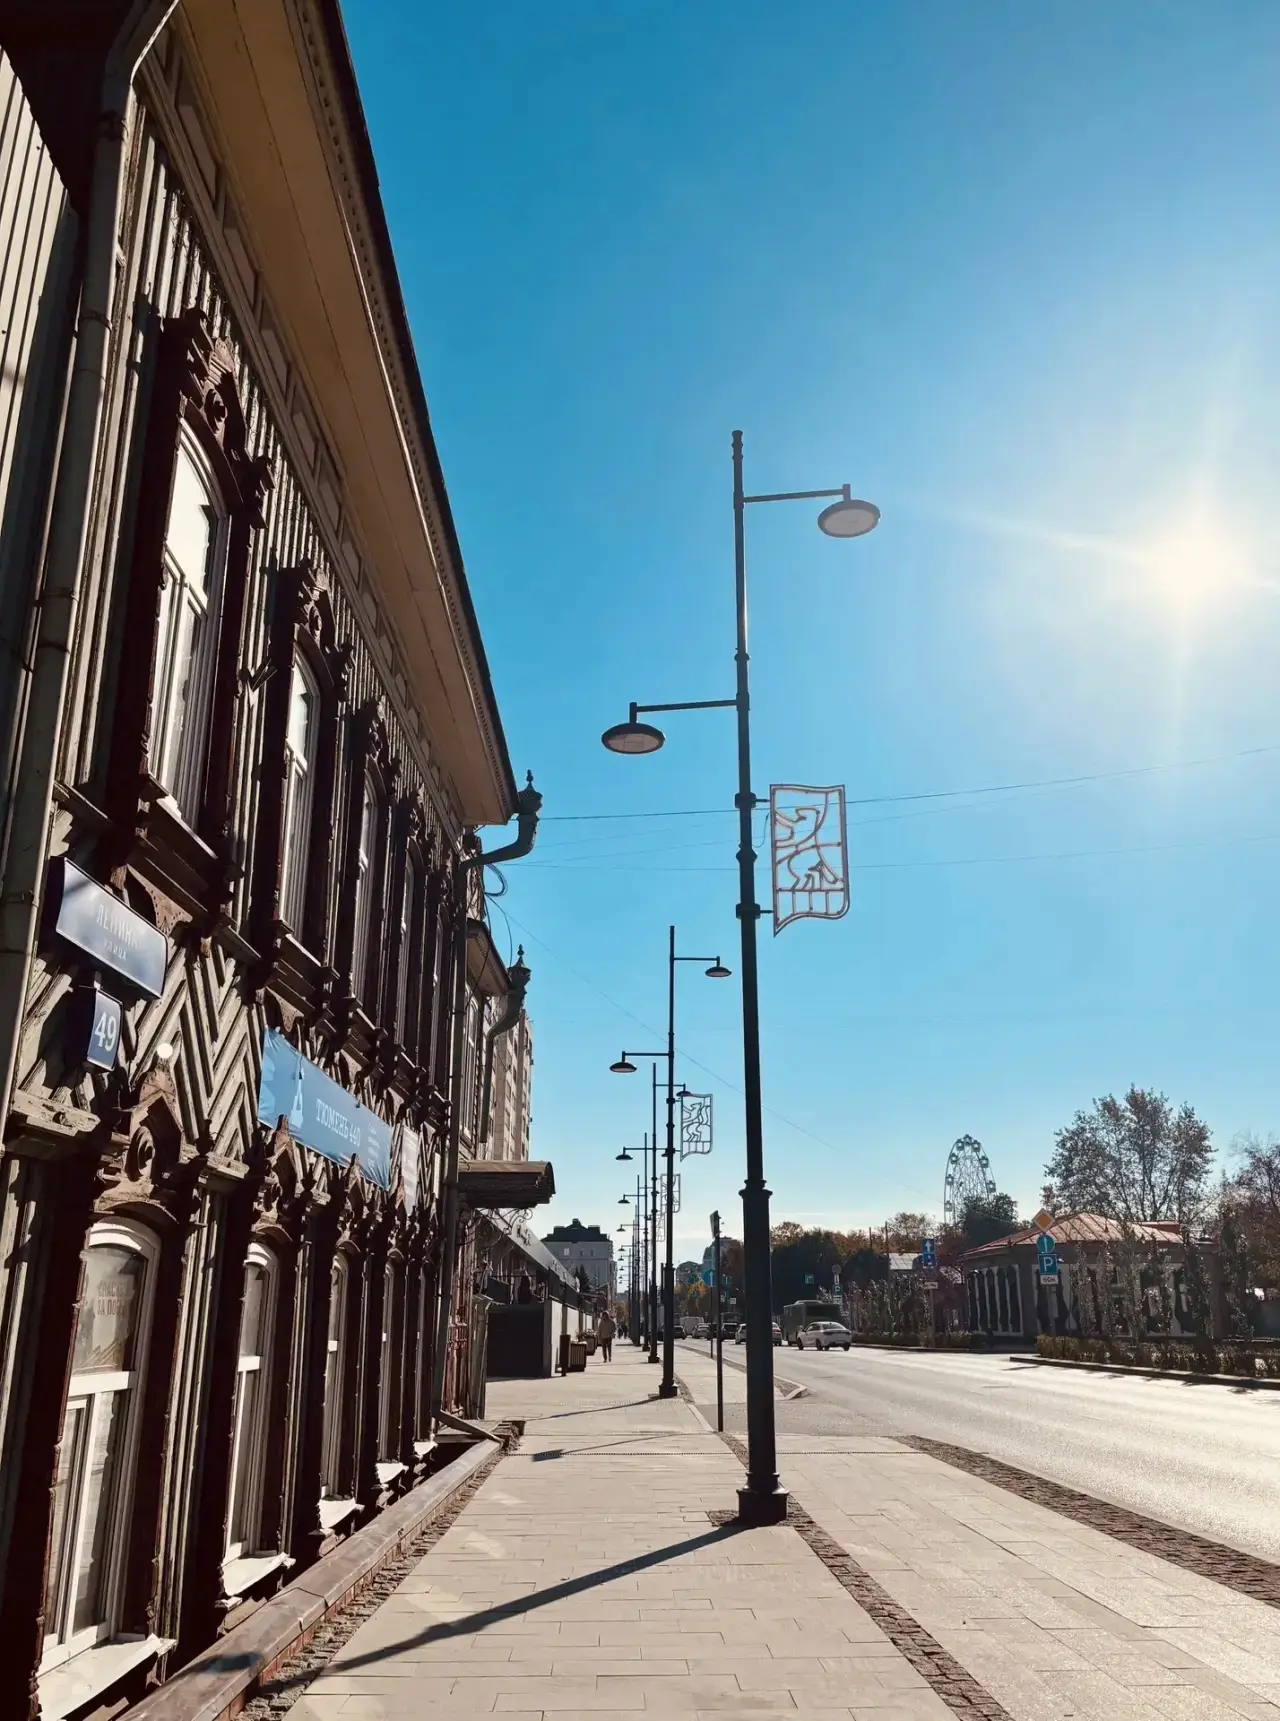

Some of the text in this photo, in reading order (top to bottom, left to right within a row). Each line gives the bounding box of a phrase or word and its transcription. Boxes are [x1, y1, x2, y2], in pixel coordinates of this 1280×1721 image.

[96, 903, 138, 949] ЛЕНИНА
[94, 1011, 117, 1052] 49
[316, 1097, 349, 1140] ТЮМЕНЬ
[1043, 1256, 1053, 1272] P
